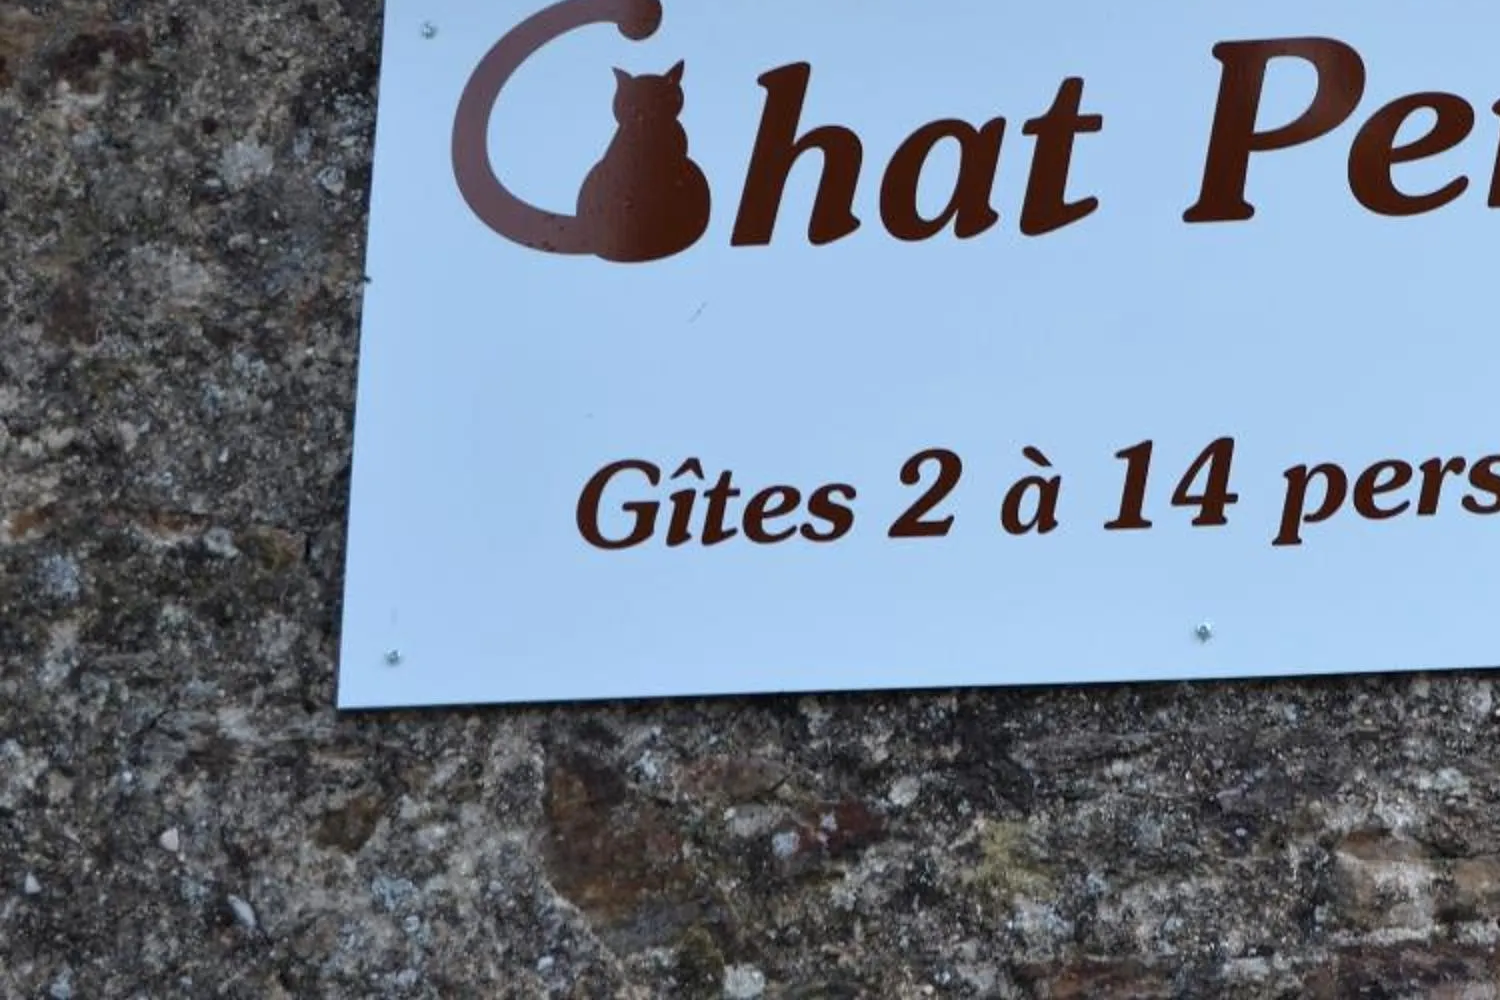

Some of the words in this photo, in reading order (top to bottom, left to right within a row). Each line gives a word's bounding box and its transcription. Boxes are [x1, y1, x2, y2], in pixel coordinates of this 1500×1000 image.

[576, 457, 857, 550] Gîtes
[887, 448, 963, 539] 2
[1000, 446, 1061, 536] à
[1103, 437, 1239, 530] 14
